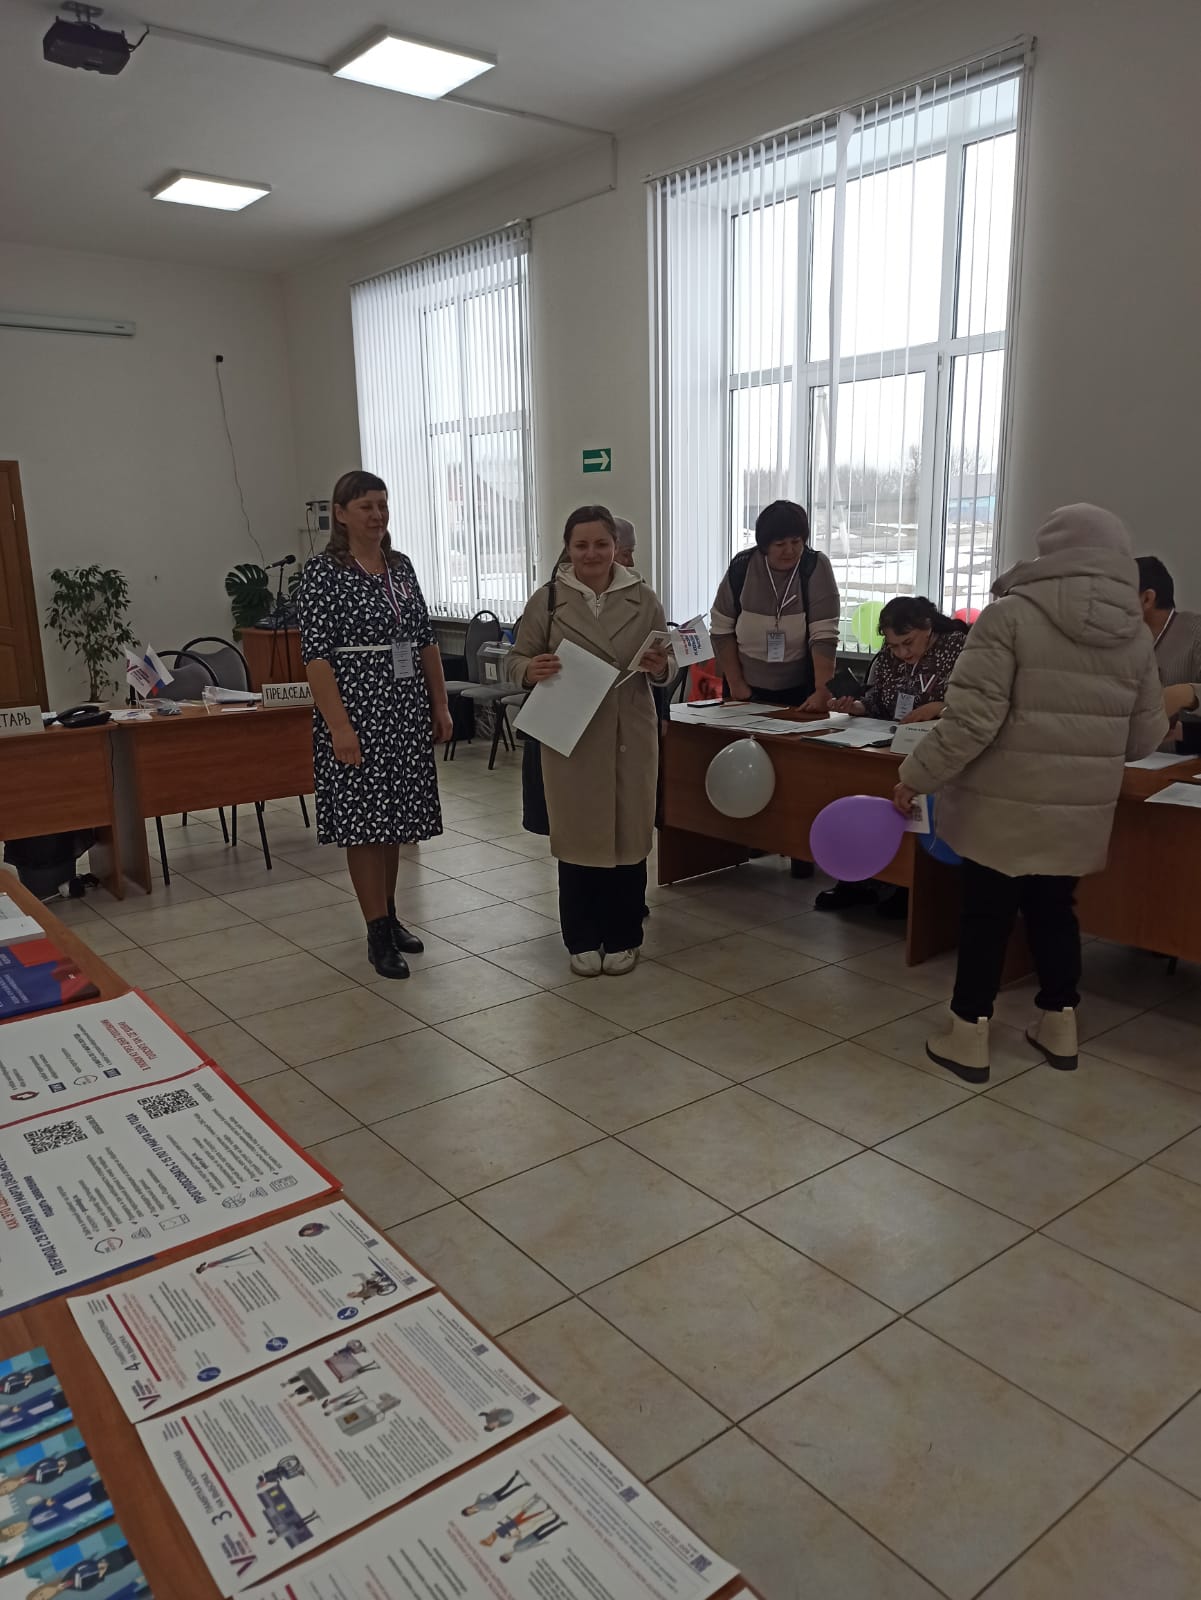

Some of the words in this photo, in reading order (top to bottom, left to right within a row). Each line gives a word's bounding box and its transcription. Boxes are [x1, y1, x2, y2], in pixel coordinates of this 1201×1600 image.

[0, 711, 31, 728] ТАРЬ
[125, 1113, 140, 1125] ГОДА
[134, 1124, 148, 1135] 2024
[141, 1133, 160, 1148] МАРТА
[169, 1165, 207, 1204] ПРОГОЛОСОВАТЬ
[8, 1185, 26, 1202] МАРТА
[19, 1206, 32, 1215] ПО
[24, 1214, 44, 1235] ЯНВАРЯ
[41, 1244, 64, 1271] ПЕРИОД
[124, 1362, 141, 1371] 4
[211, 1510, 232, 1526] 3
